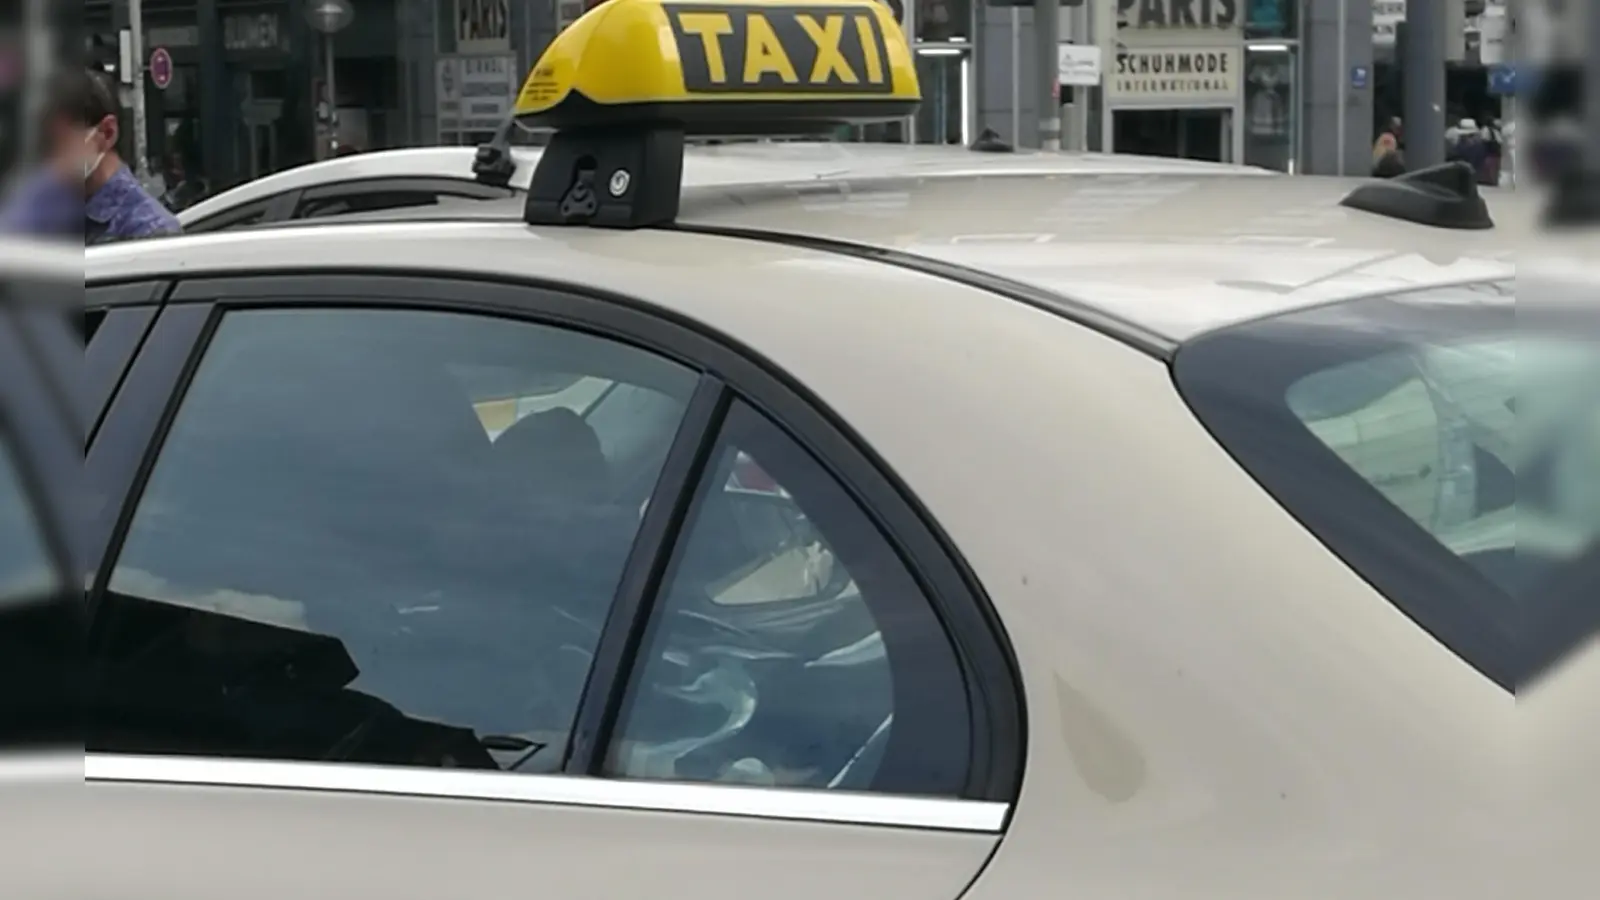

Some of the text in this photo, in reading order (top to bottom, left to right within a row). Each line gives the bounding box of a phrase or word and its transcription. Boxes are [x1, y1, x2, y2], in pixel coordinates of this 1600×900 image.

[1116, 0, 1236, 29] PARIS
[677, 12, 884, 84] TAXI
[1116, 52, 1228, 74] SCHUHMODE
[1116, 77, 1229, 92] INTERNATIONAL
